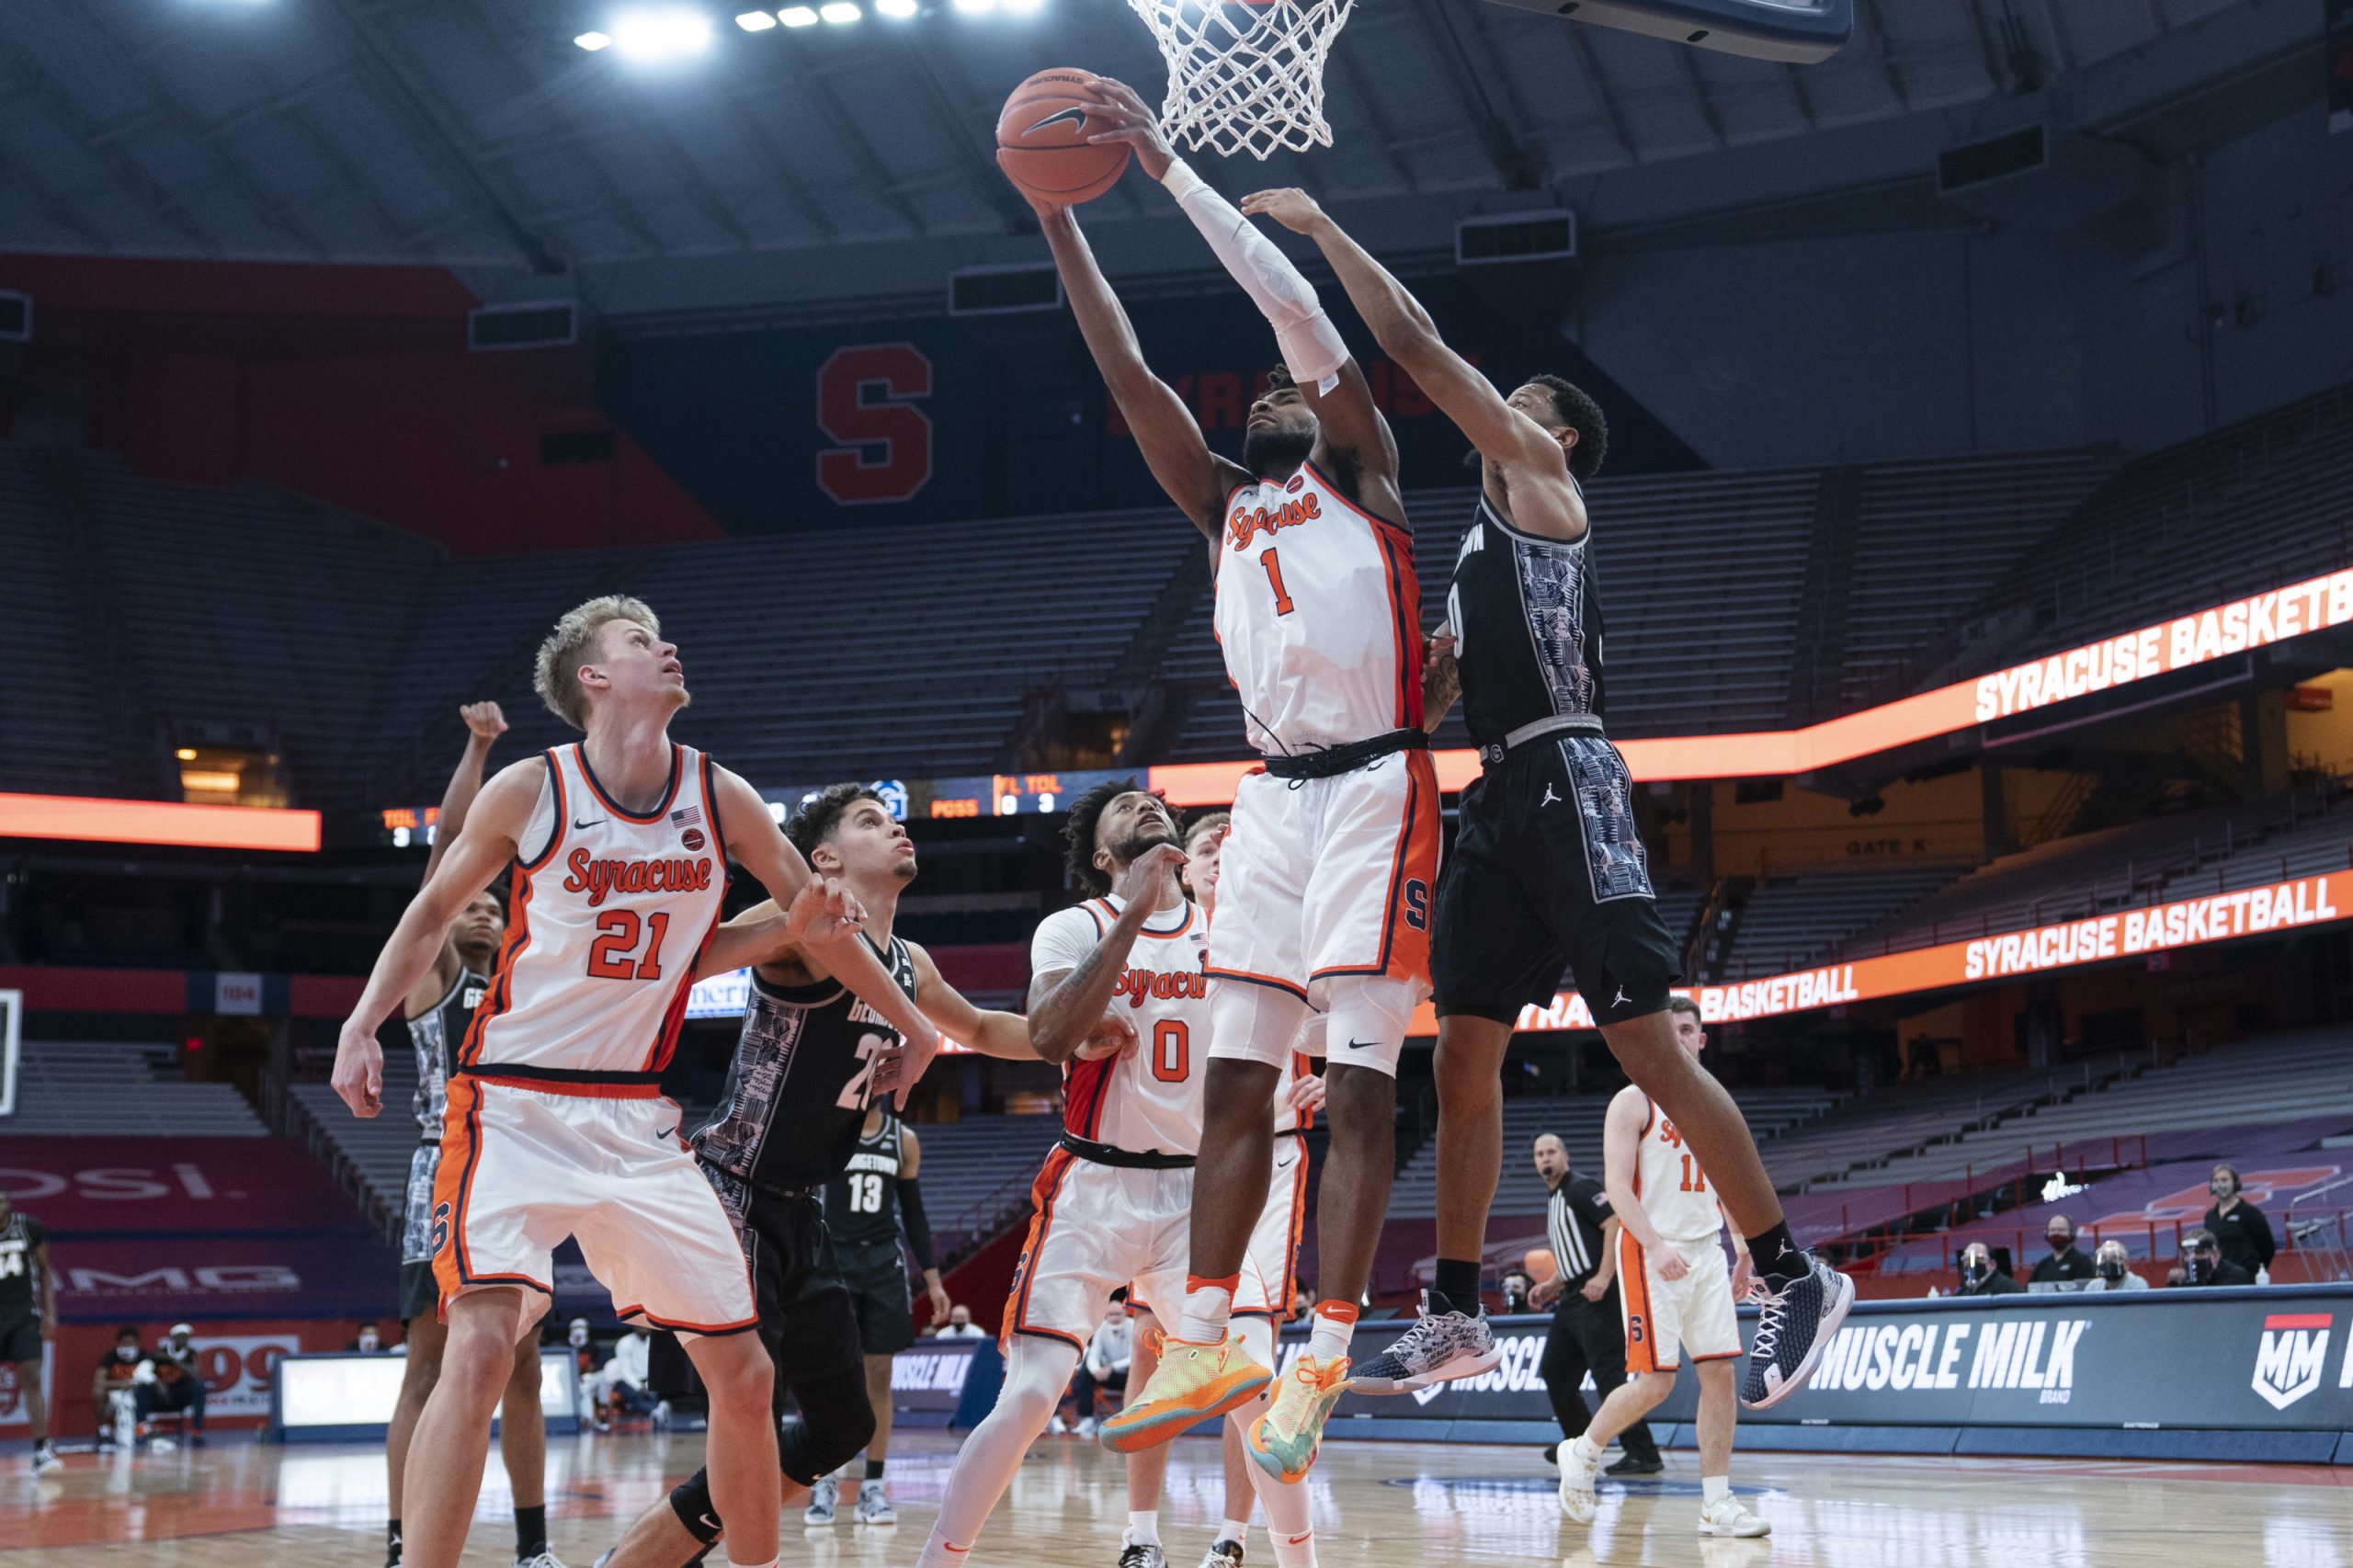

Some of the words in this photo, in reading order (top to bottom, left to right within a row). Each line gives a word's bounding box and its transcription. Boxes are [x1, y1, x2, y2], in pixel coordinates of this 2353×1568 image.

[816, 341, 932, 506] S
[1260, 547, 1294, 617] 1
[1975, 627, 2163, 722] SYRACUSE
[563, 847, 711, 906] Syracuse
[1404, 878, 1427, 932] S
[587, 909, 669, 980] 21
[1965, 916, 2119, 980] SYRACUSE
[2124, 878, 2336, 952] BASKETBALL
[1699, 966, 1859, 1023] BASKETBALL
[1153, 1019, 1189, 1083] 0
[848, 1173, 882, 1212] 13
[1680, 1154, 1705, 1191] 11
[1808, 1324, 1971, 1391] MUSCLE
[1967, 1321, 2086, 1389] MILK
[2039, 1389, 2072, 1404] BRAND
